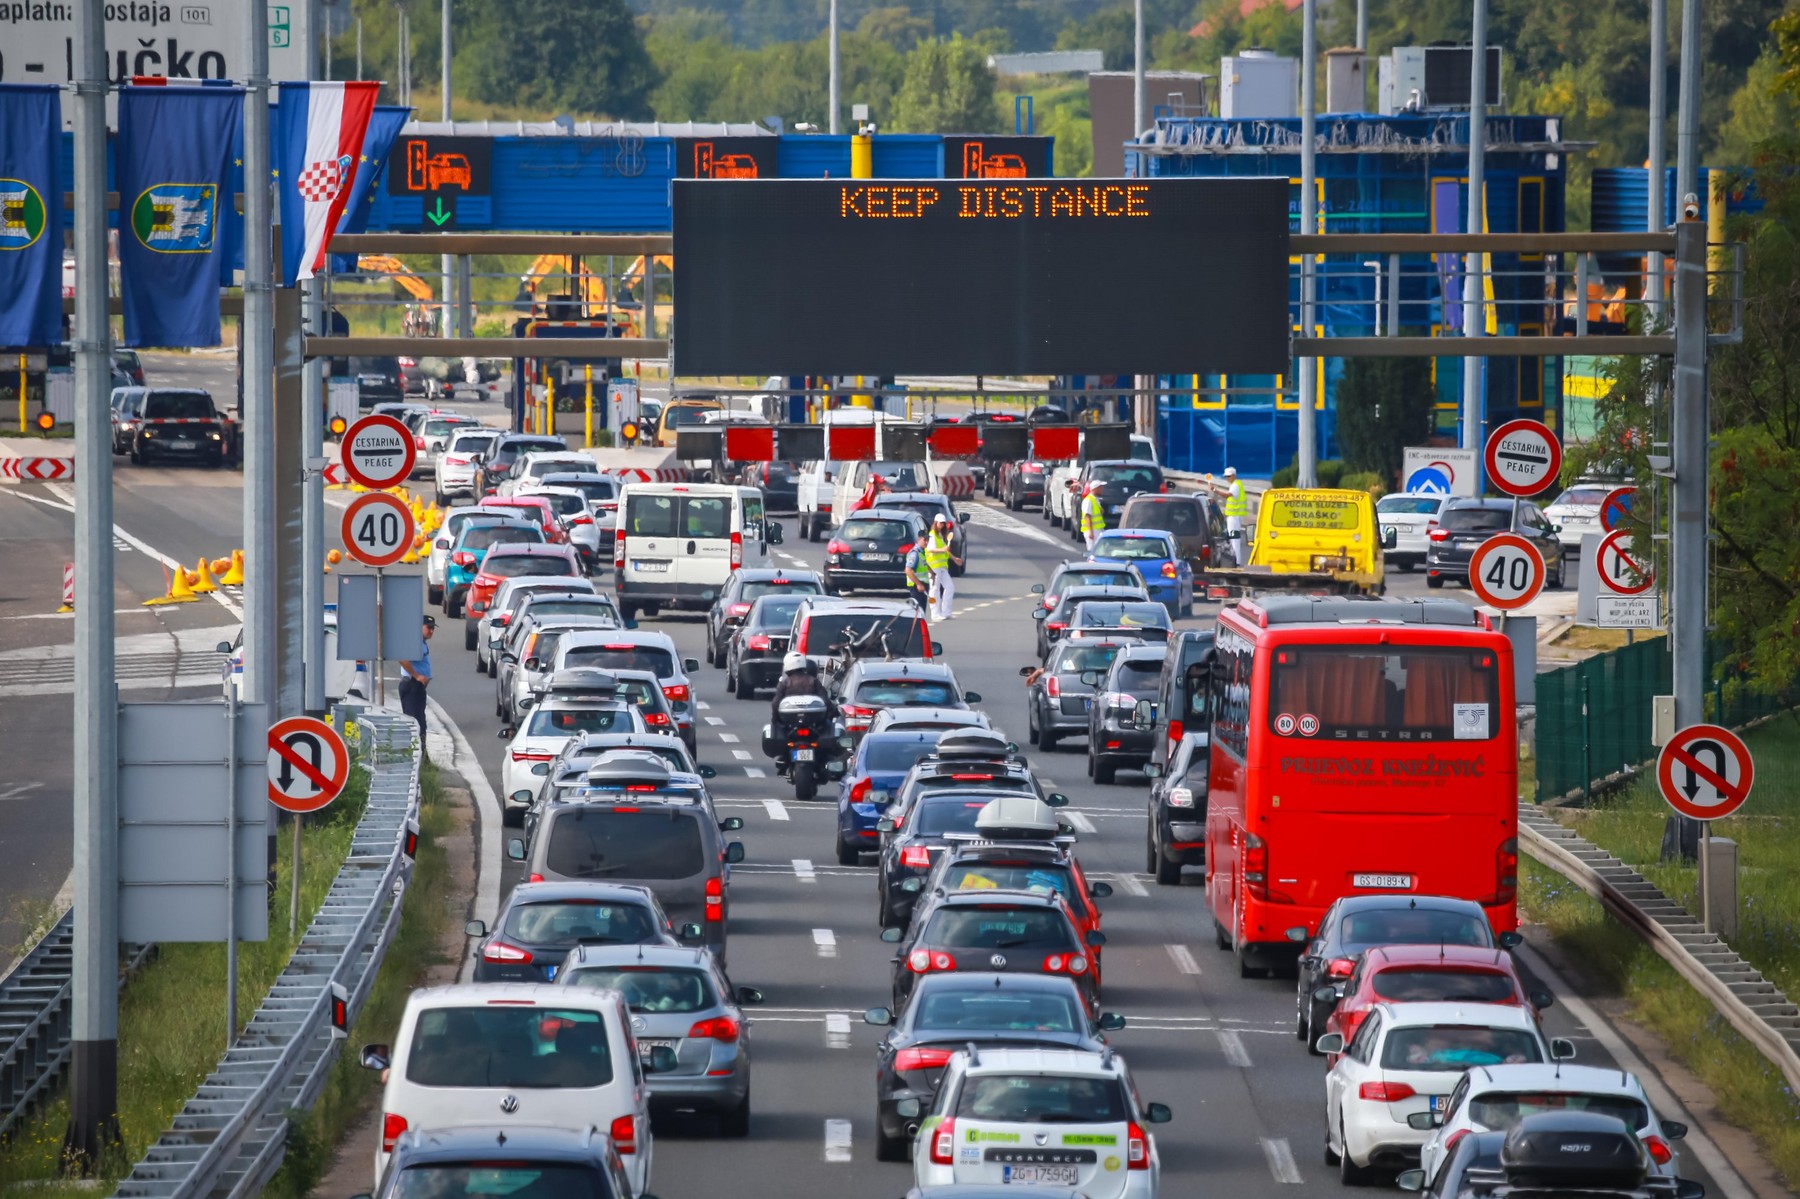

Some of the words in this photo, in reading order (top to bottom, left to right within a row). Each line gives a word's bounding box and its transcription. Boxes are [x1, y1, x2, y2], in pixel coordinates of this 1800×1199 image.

[104, 3, 171, 26] ostaja
[185, 9, 207, 22] 101
[841, 186, 940, 218] KEEP
[957, 186, 1150, 217] DISTANCE
[355, 437, 401, 448] CESTARINA
[1501, 440, 1547, 455] CESTARINA
[364, 457, 393, 468] PEAGE
[1506, 461, 1537, 475] PEAGE
[358, 512, 399, 547] 40
[1485, 555, 1530, 591] 40
[1279, 719, 1291, 729] 80
[1301, 720, 1316, 730] 100
[1335, 730, 1433, 740] SETRA
[1280, 756, 1375, 775] PRIJEVOZ
[1381, 754, 1486, 778] KNEŽEVIĆ
[1359, 875, 1371, 887] GS
[1011, 1165, 1026, 1181] ZG
